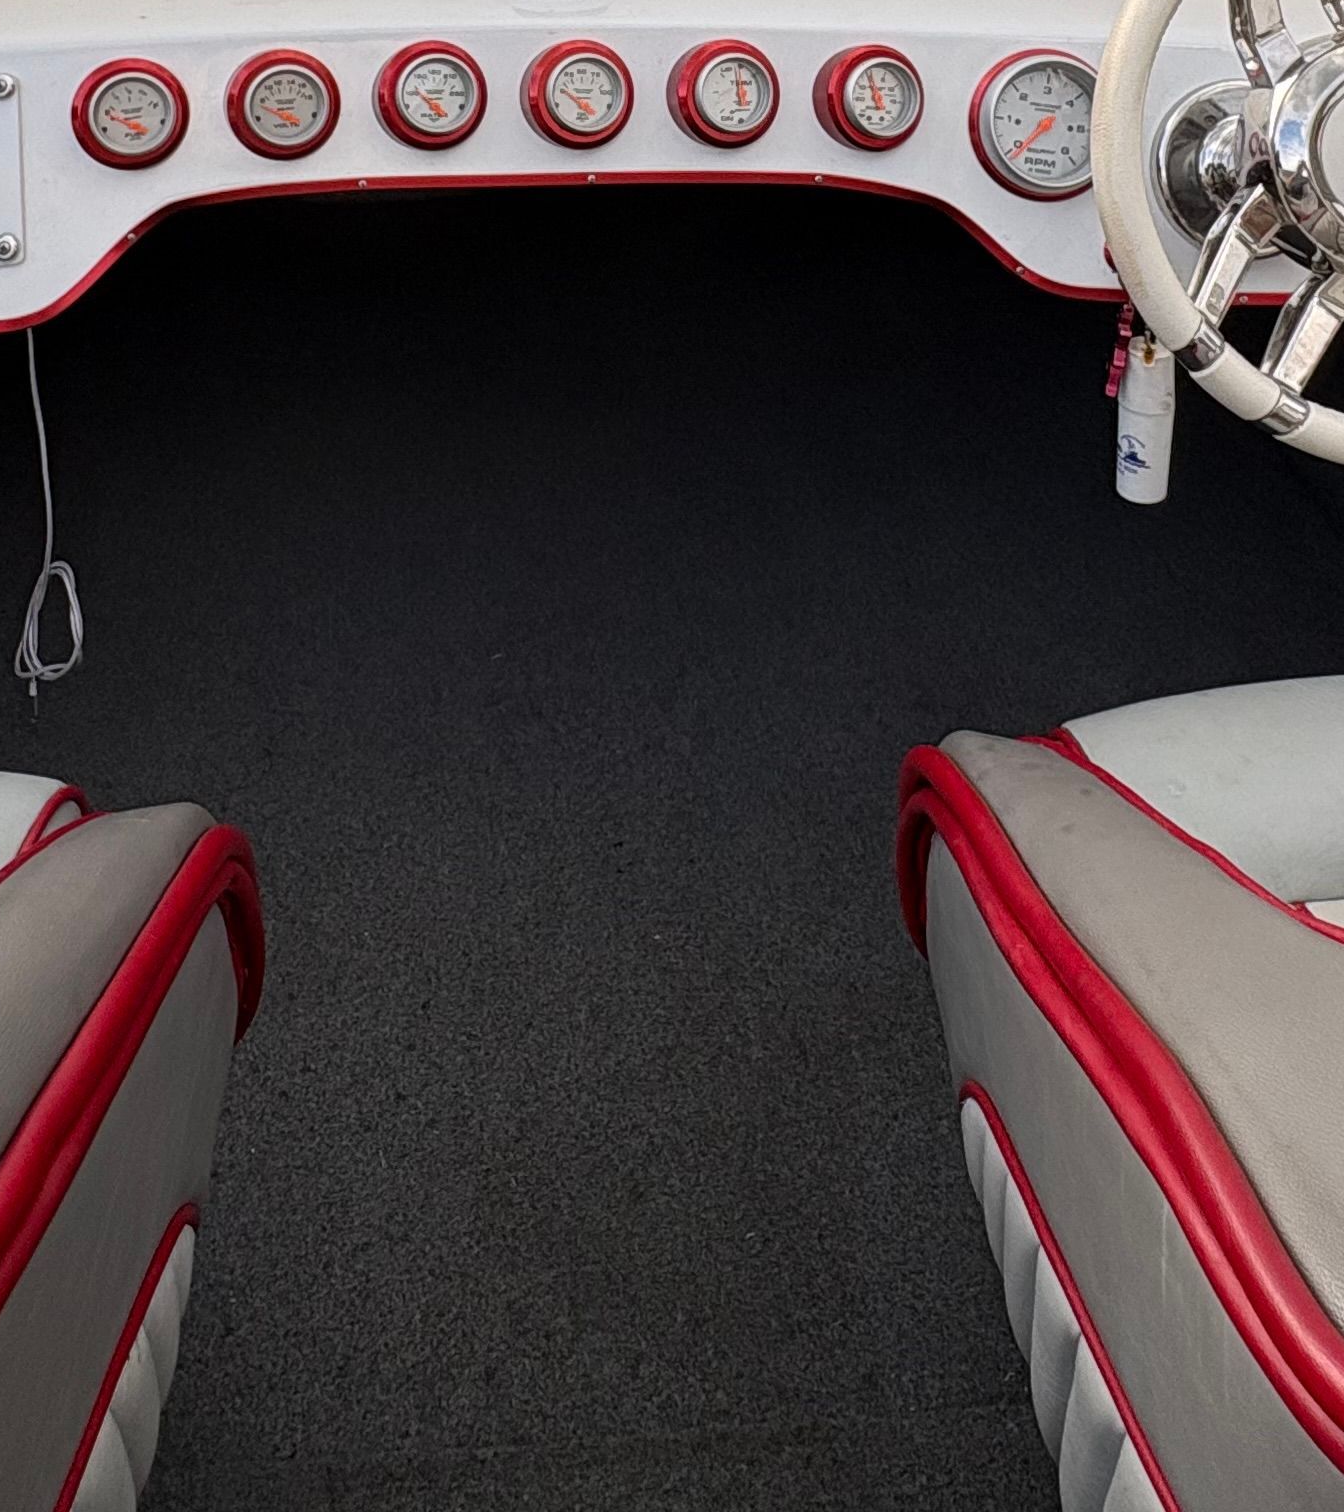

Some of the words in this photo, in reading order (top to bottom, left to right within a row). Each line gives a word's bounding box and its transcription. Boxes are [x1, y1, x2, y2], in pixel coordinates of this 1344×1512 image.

[1043, 86, 1052, 95] 3
[1019, 92, 1028, 101] 2
[1065, 99, 1075, 108] 4
[1007, 115, 1012, 123] 1
[1076, 124, 1086, 133] 5
[1014, 140, 1023, 149] 0
[1061, 146, 1070, 155] 6
[1024, 157, 1056, 169] RPM
